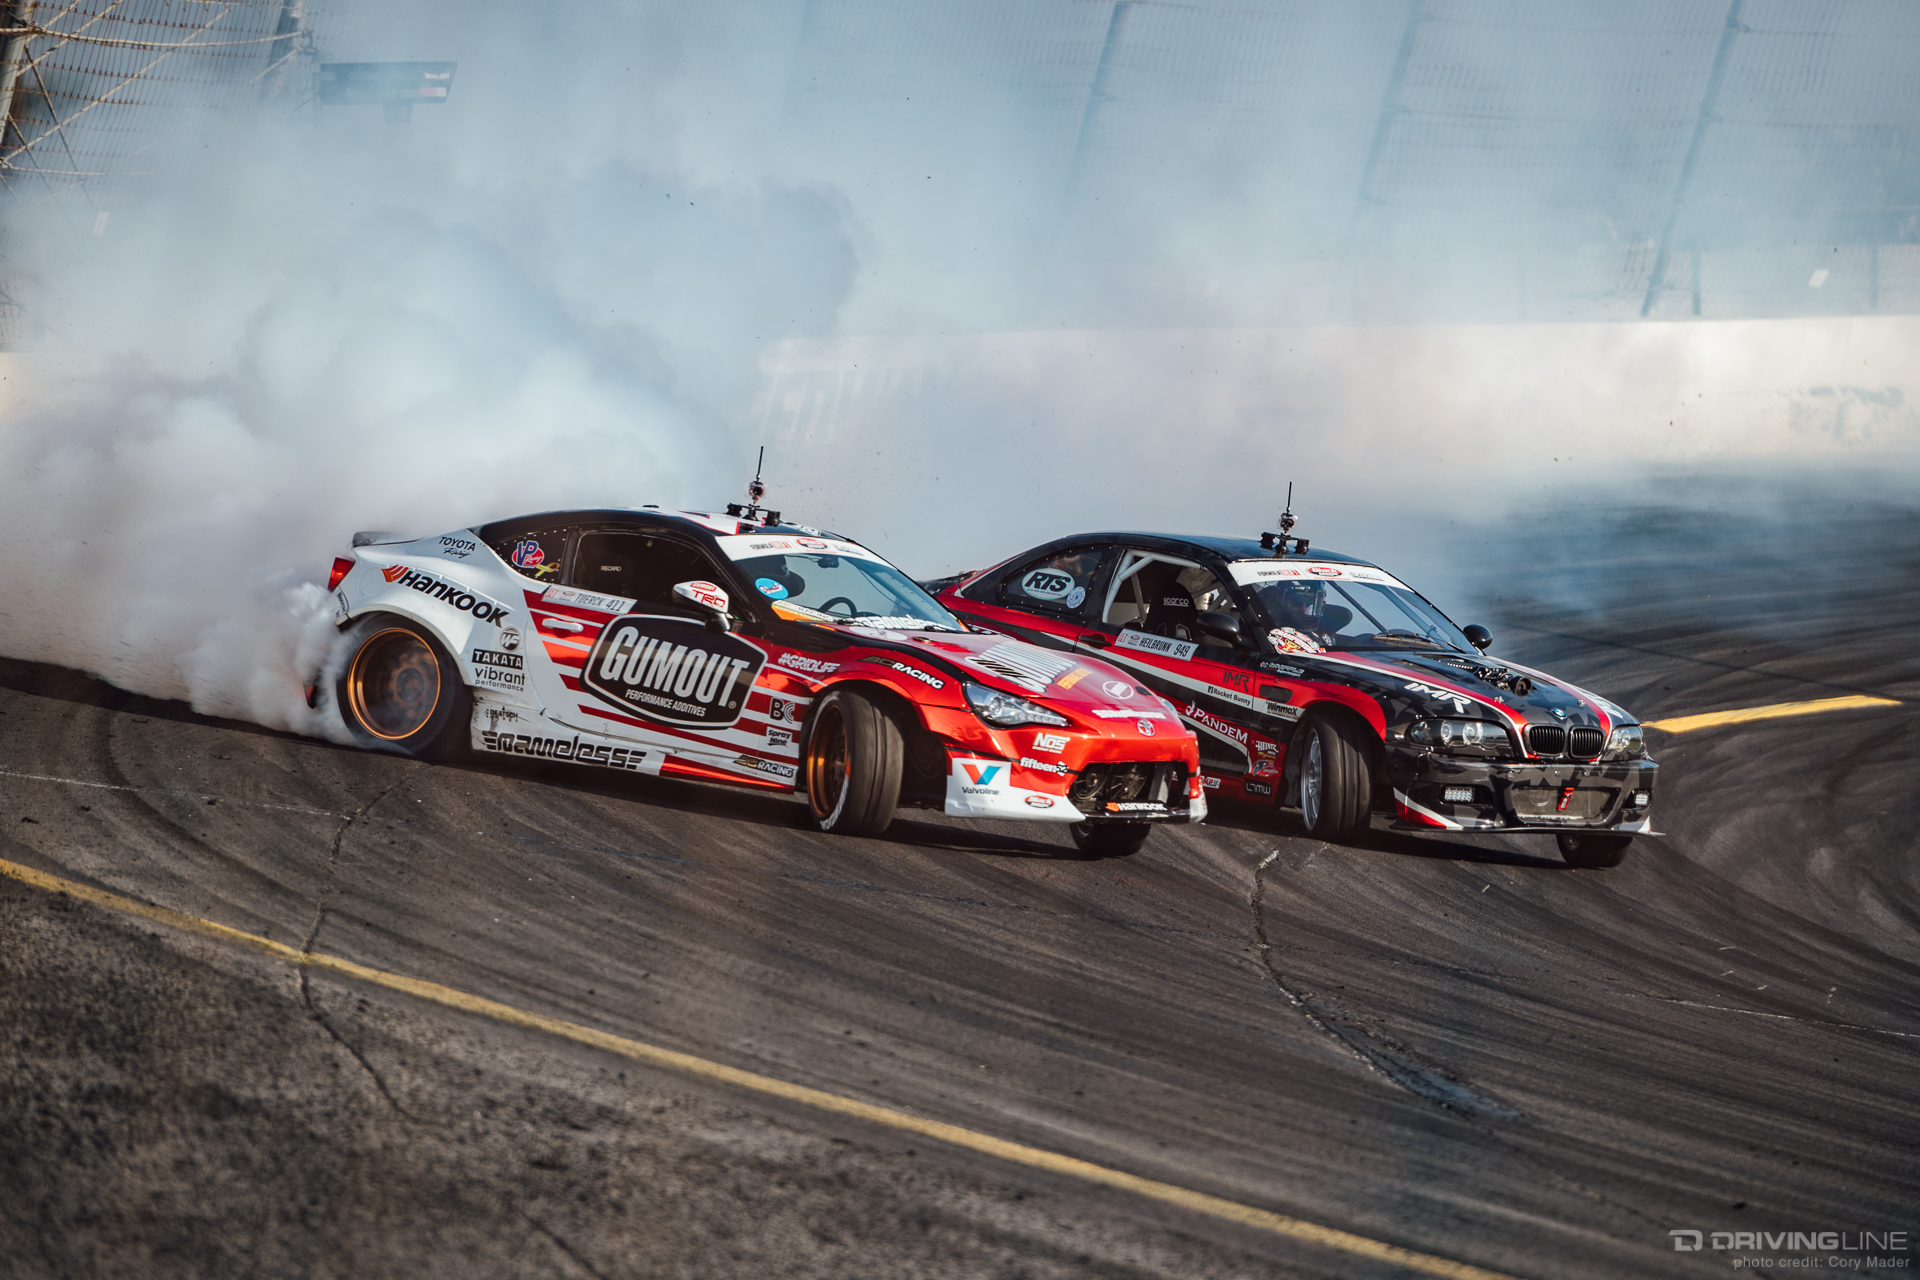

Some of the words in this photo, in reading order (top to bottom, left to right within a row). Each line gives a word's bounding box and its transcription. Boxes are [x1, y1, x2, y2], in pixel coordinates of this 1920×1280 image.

[439, 537, 476, 551] TOYOTA
[516, 540, 539, 566] VP
[1024, 571, 1071, 592] RTS
[575, 594, 606, 607] TUERCK
[606, 599, 626, 612] 411
[692, 589, 726, 607] TRD
[1138, 637, 1172, 652] HEILBRUNN
[1173, 643, 1191, 657] 949
[474, 650, 522, 668] TAKATA
[600, 626, 750, 707] GUMOUT
[778, 652, 841, 673] #GRIDLIFE
[475, 666, 525, 686] vibrant
[892, 662, 944, 689] RACING
[1223, 670, 1250, 693] IMR
[475, 679, 524, 692] performance
[625, 689, 674, 709] PERFORMANCE
[672, 701, 706, 717] ADDITIVES
[1213, 689, 1233, 700] Rocket
[1233, 695, 1252, 706] Bunny
[1404, 682, 1472, 714] IMR
[768, 729, 791, 739] Spray
[1194, 708, 1248, 744] PANDEM
[769, 738, 788, 746] Nine
[1033, 732, 1071, 751] NOS
[1255, 741, 1279, 753] HEINTZ
[757, 761, 793, 777] RACING
[962, 787, 1000, 796] Valvoline
